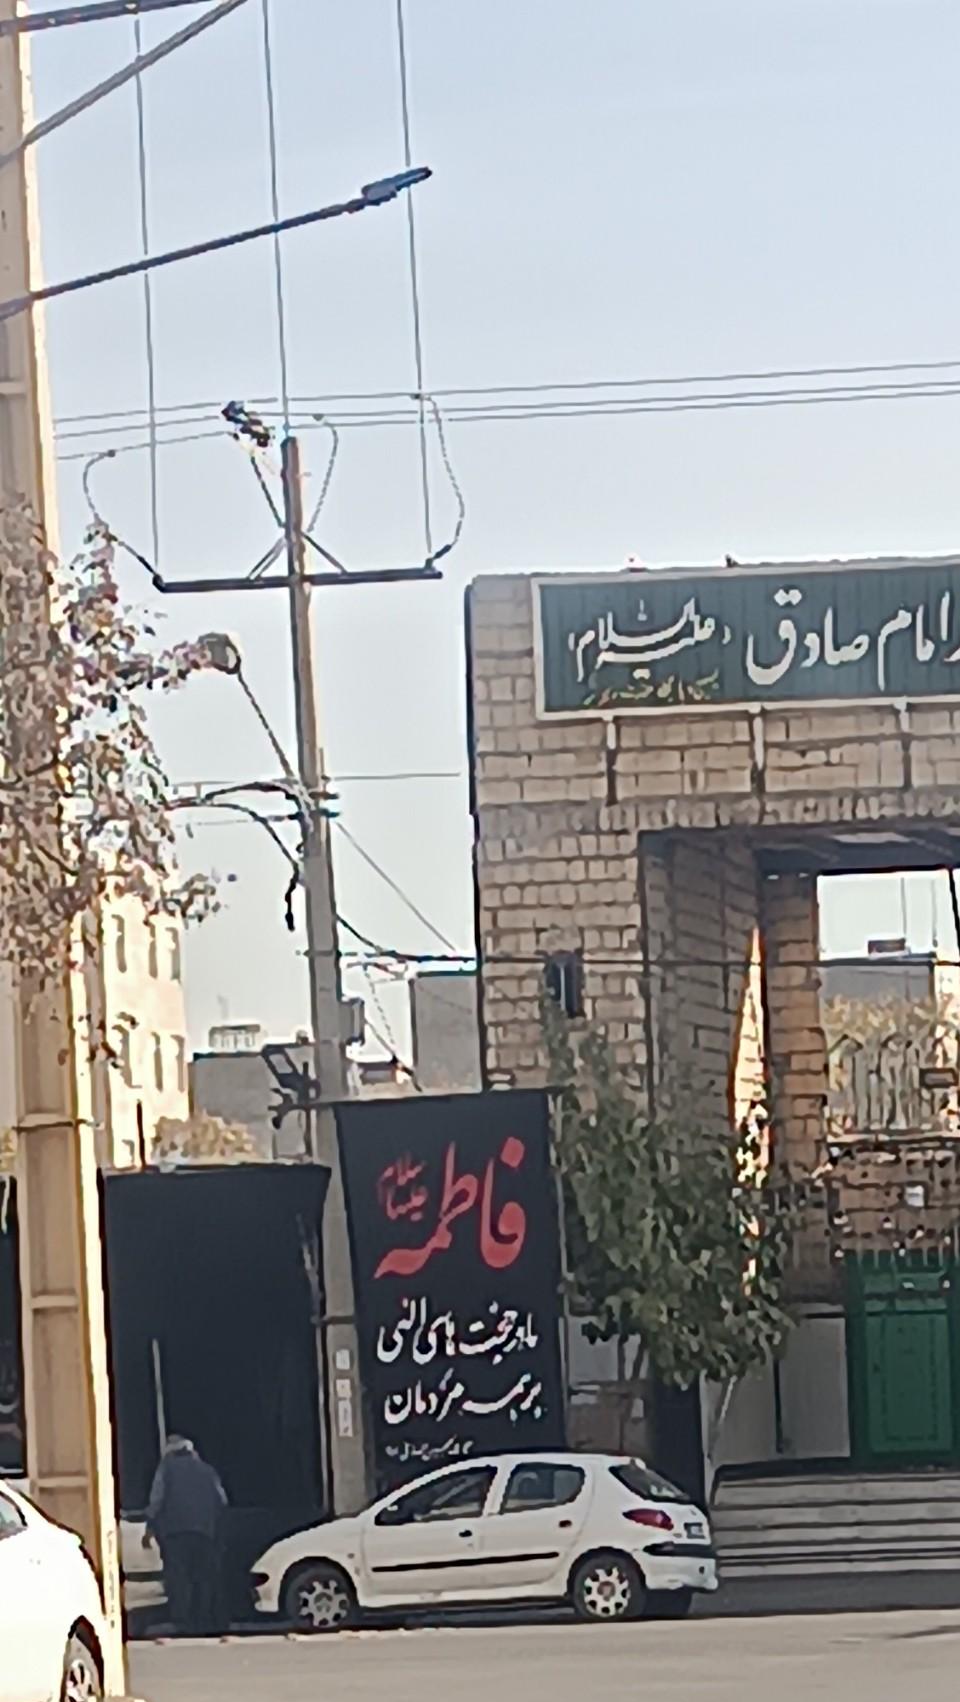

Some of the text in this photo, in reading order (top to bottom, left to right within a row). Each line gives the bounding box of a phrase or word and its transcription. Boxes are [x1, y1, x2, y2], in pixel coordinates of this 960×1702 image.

[745, 588, 871, 686] صادق
[877, 590, 950, 692] امام
[374, 1136, 526, 1280] فاطمه
[384, 1368, 466, 1425] مردمان
